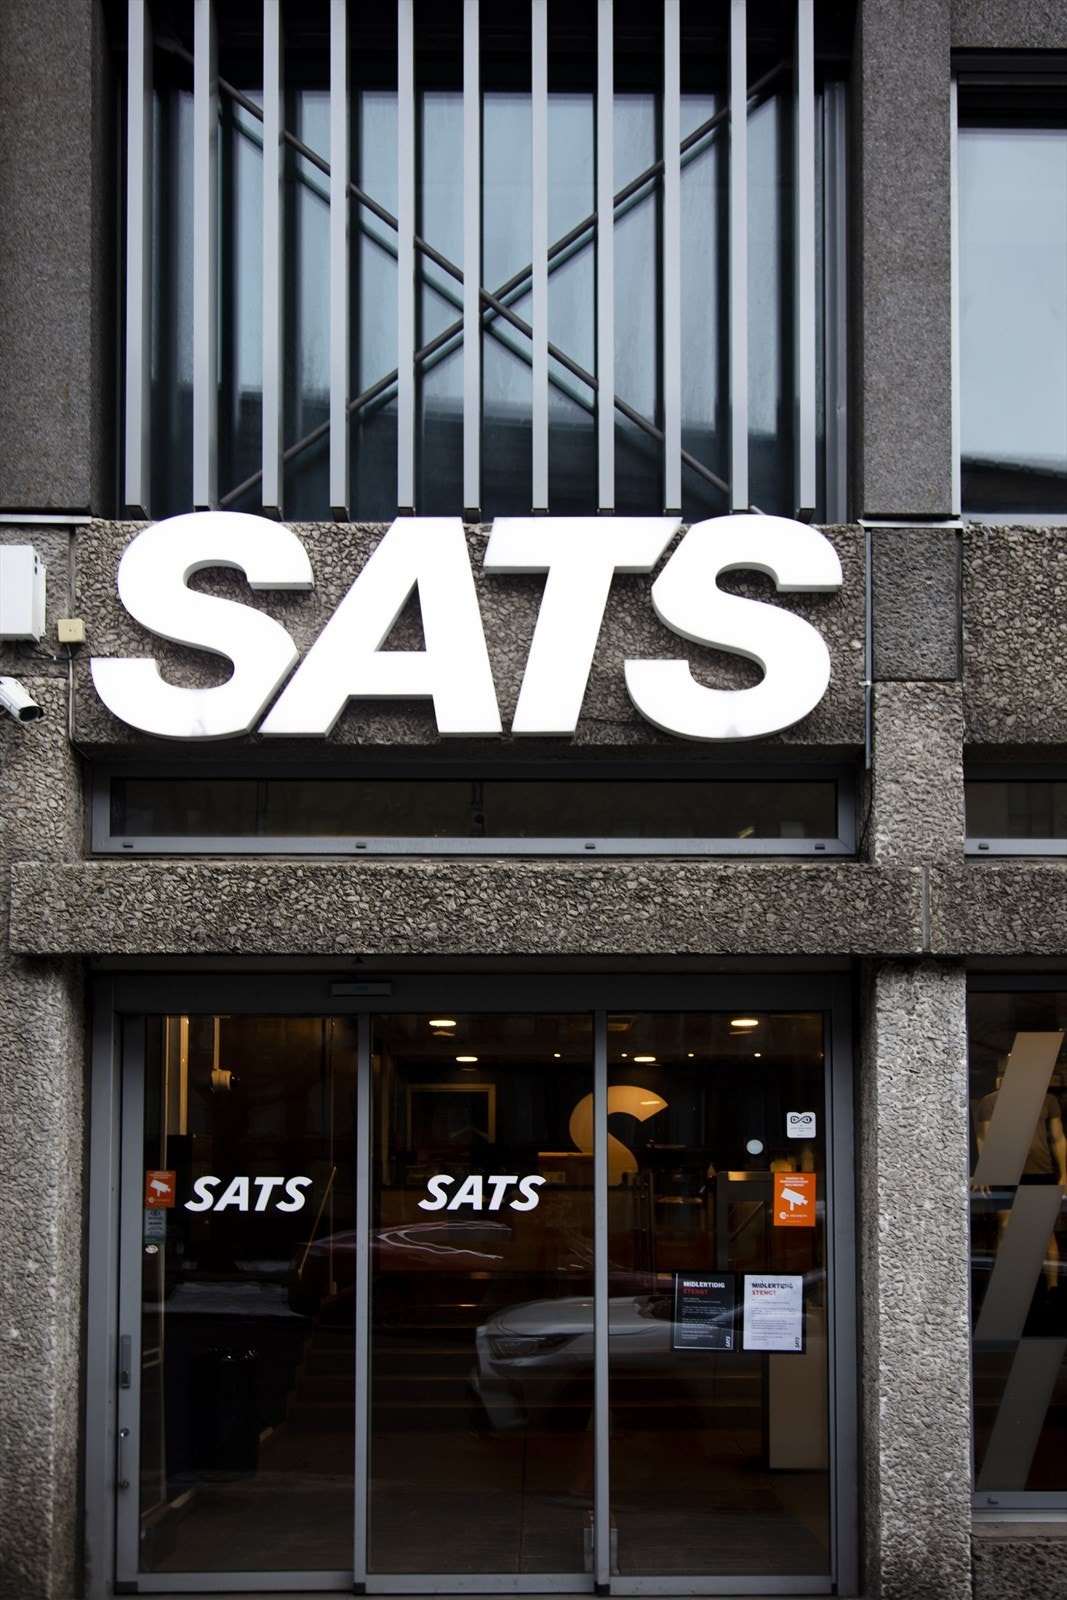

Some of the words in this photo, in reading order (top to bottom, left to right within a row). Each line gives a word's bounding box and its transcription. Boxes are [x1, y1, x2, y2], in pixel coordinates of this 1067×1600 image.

[90, 512, 843, 737] SATS
[184, 1175, 313, 1212] SATS
[418, 1175, 547, 1212] SATS
